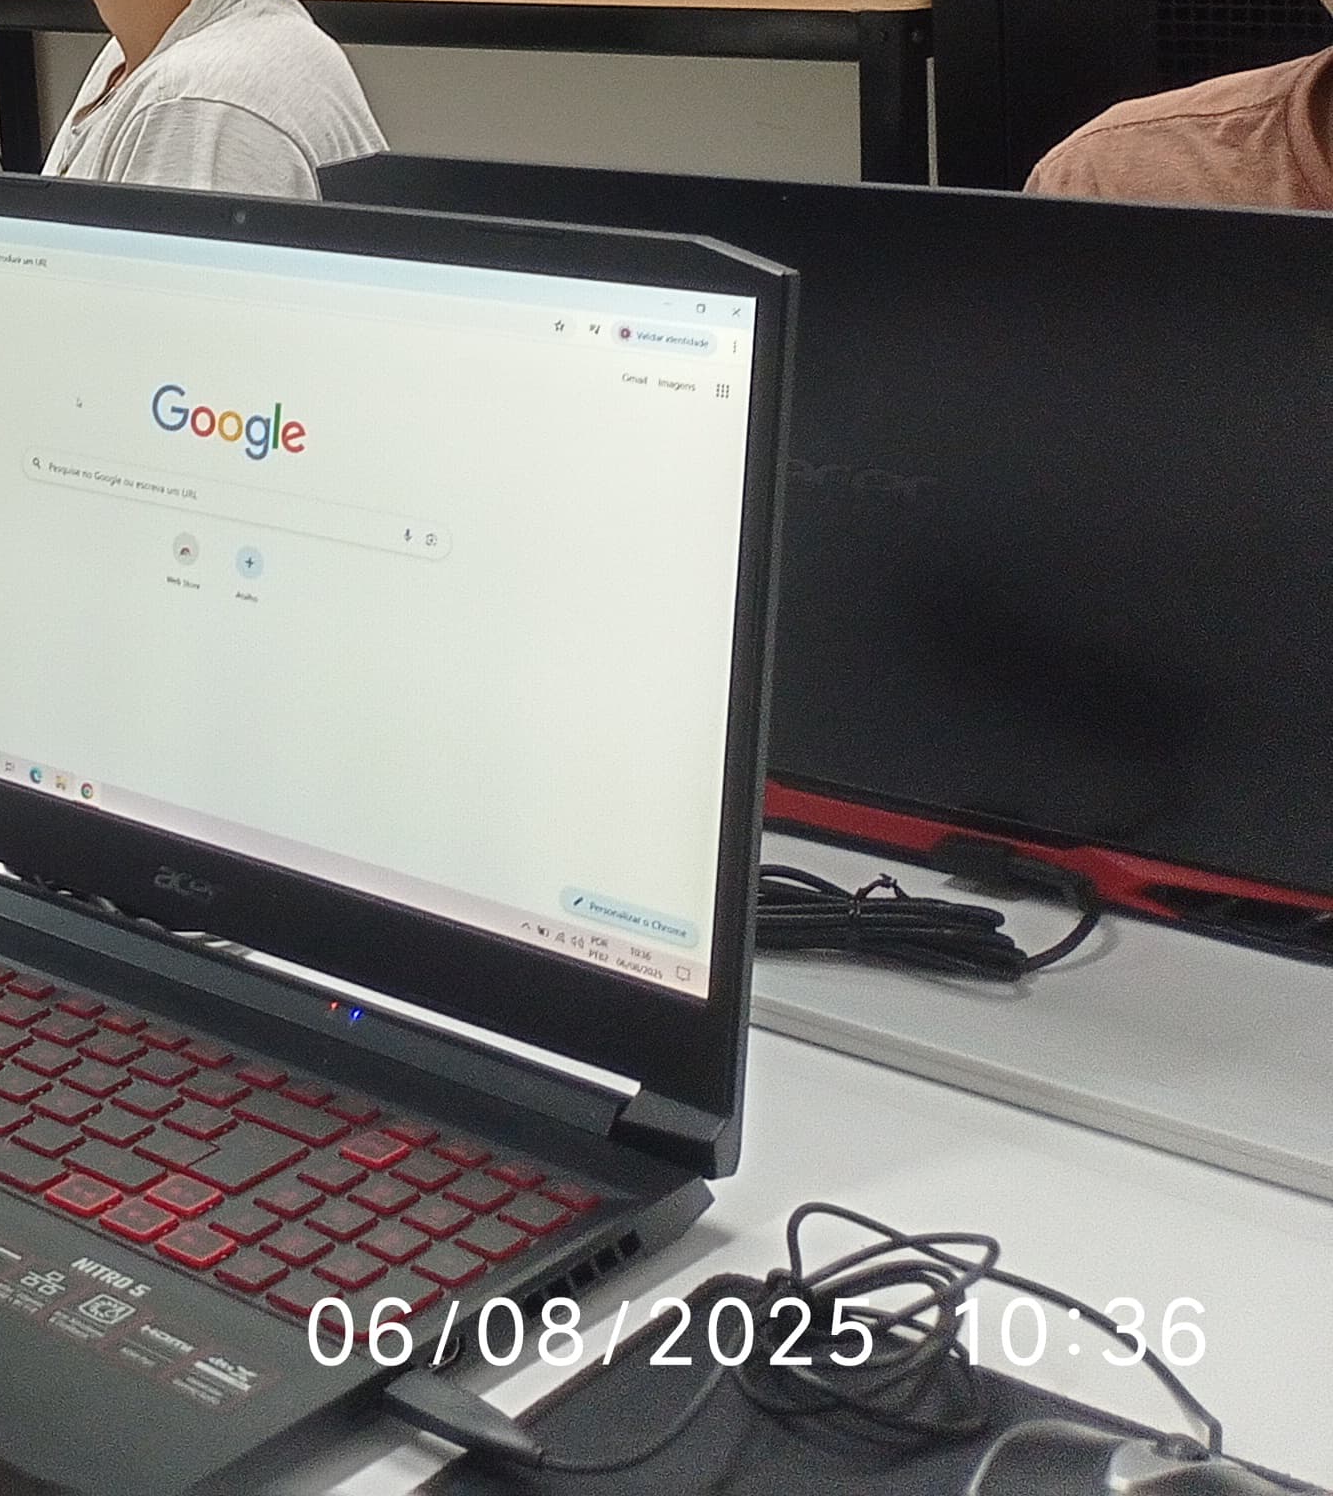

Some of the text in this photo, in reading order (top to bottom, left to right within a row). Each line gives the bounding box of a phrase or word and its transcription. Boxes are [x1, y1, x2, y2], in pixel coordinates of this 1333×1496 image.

[621, 372, 648, 385] Gmail
[658, 378, 696, 392] Imagens
[152, 384, 307, 461] Google
[48, 462, 80, 476] Pesquise
[94, 471, 121, 487] Google
[136, 481, 165, 494] escreva
[182, 489, 197, 500] URL
[589, 901, 641, 925] Personalizar
[651, 920, 687, 938] Chrome
[71, 1257, 152, 1297] NITRO 5
